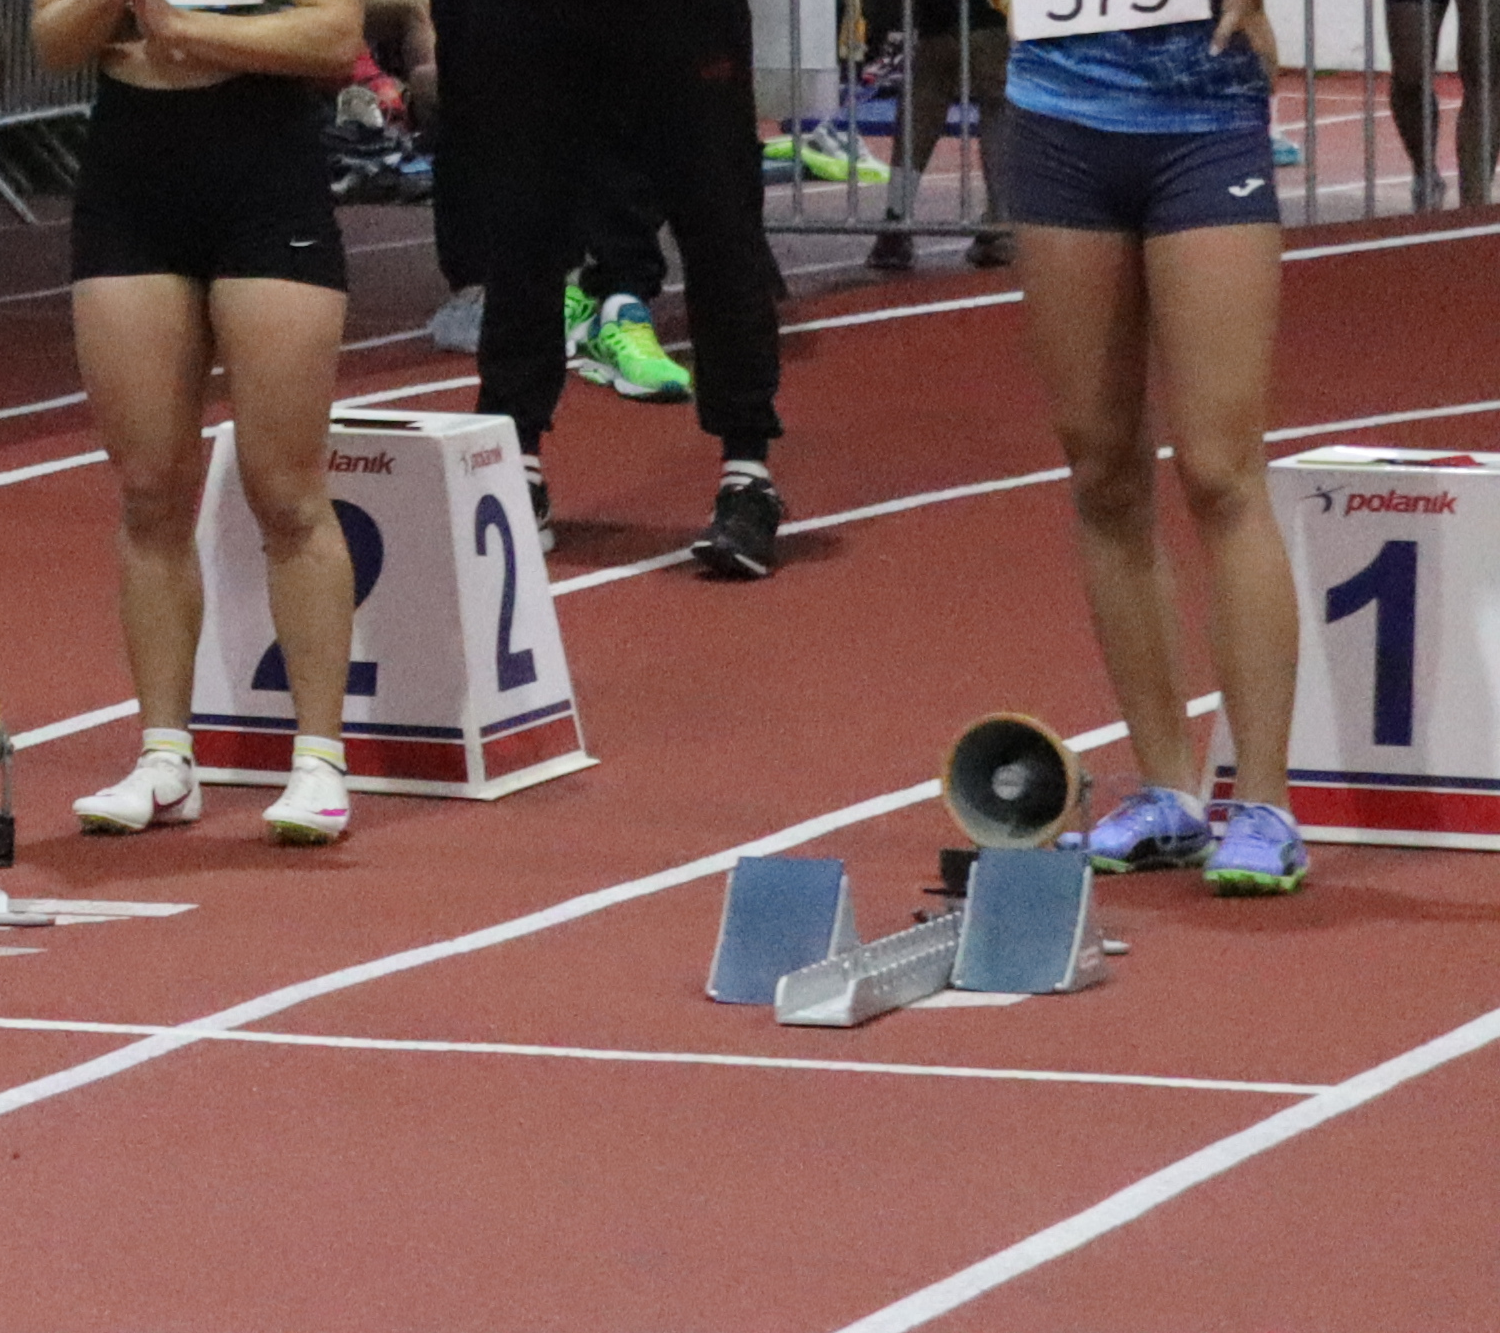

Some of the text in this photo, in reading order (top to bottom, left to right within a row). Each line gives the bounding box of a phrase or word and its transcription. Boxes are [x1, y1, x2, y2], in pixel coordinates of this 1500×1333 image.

[328, 449, 396, 476] lanik
[1343, 489, 1459, 518] polanik
[475, 494, 537, 693] 2
[1325, 539, 1418, 747] 1
